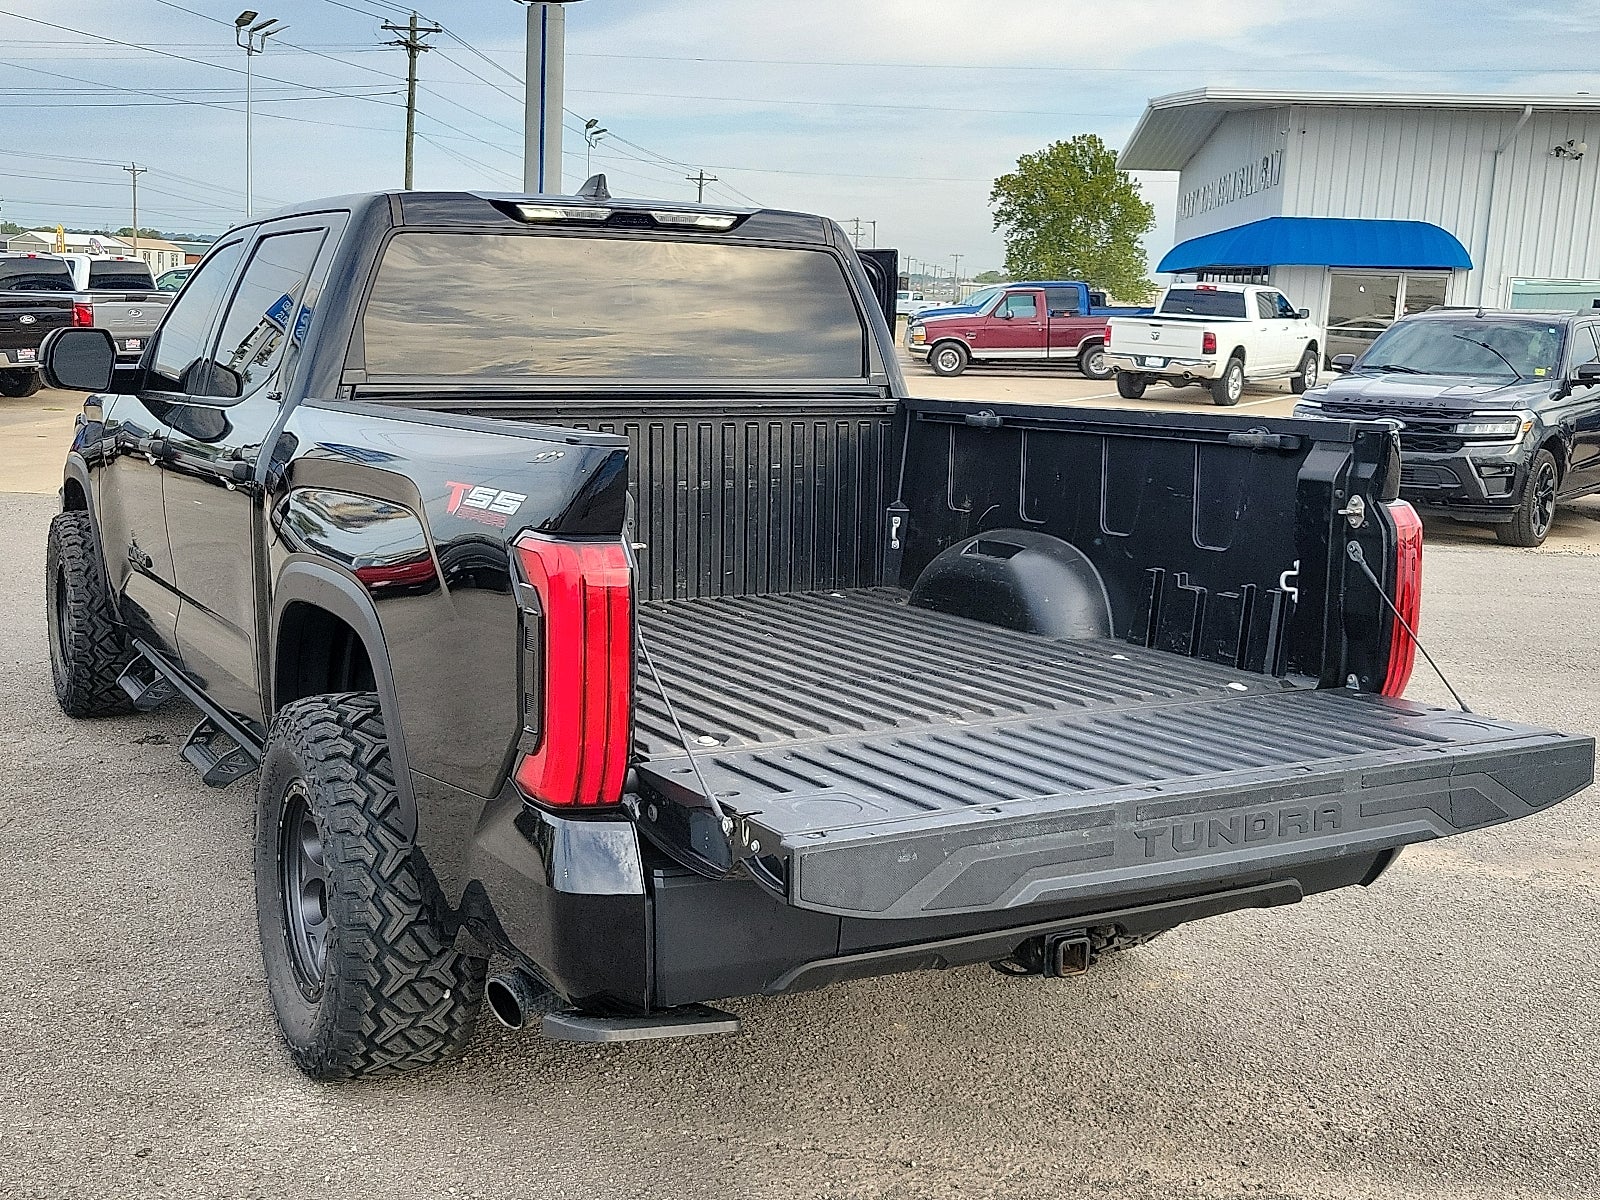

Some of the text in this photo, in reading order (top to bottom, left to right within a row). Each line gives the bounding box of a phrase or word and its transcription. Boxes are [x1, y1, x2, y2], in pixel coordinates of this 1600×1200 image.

[1342, 397, 1447, 408] EXPEDITION
[445, 480, 528, 516] TSS
[1134, 801, 1343, 858] TUNDRA
